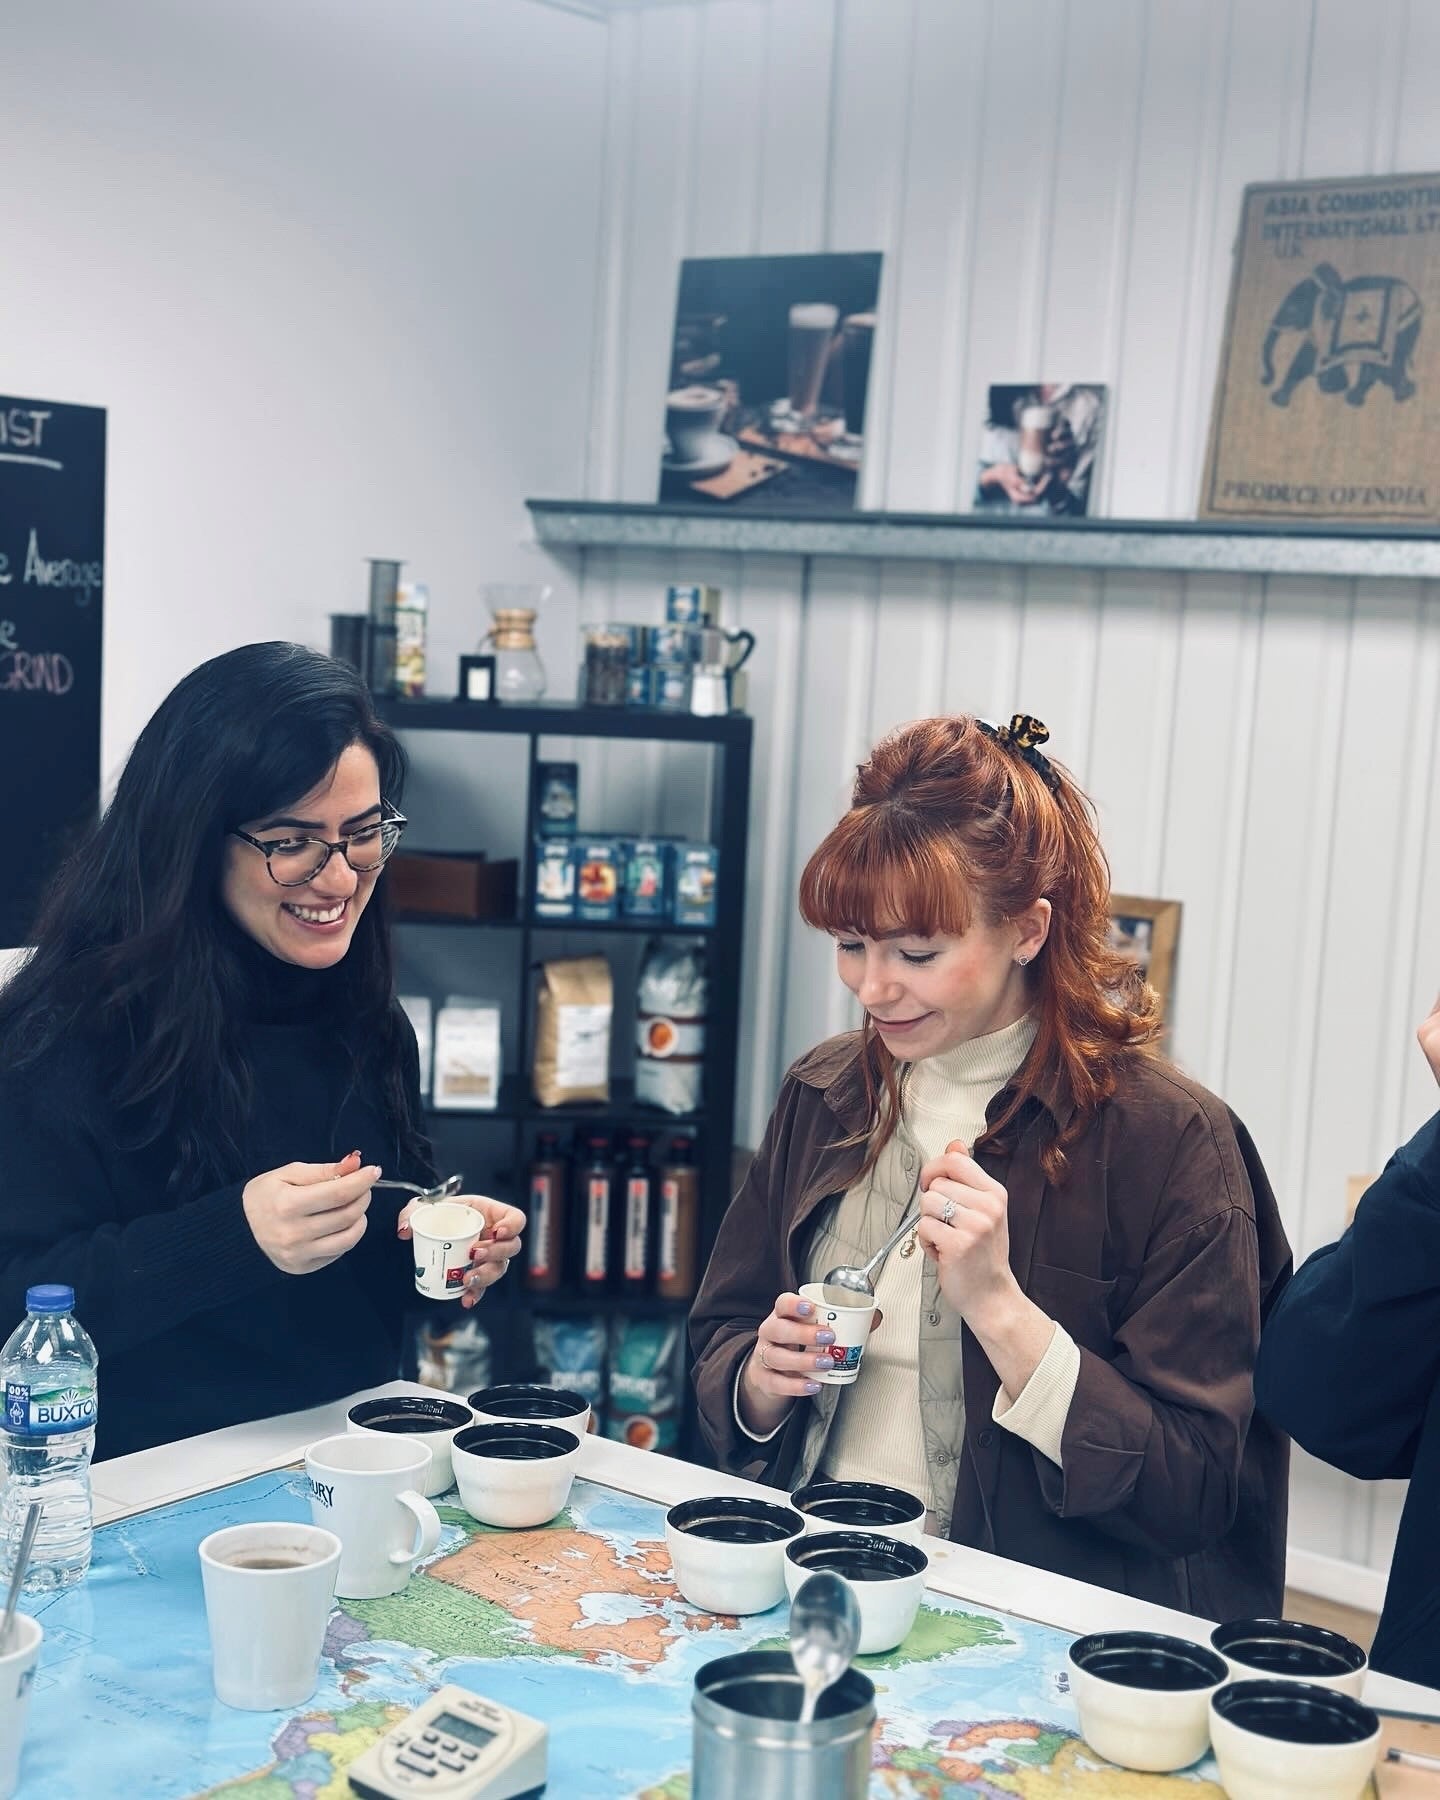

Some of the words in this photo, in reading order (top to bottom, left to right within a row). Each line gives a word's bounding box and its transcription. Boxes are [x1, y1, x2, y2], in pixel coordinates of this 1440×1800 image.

[1265, 196, 1309, 215] ASIA
[1262, 215, 1408, 241] INTERNATIONAL
[1415, 209, 1440, 232] LT
[1223, 481, 1319, 504] PRODUCE
[1360, 486, 1427, 506] INDIA
[23, 528, 103, 607] Average
[8, 1385, 29, 1396] 00%
[512, 1552, 572, 1583] CANADA
[440, 1579, 495, 1605] AMERICA
[494, 1572, 539, 1591] NORTH
